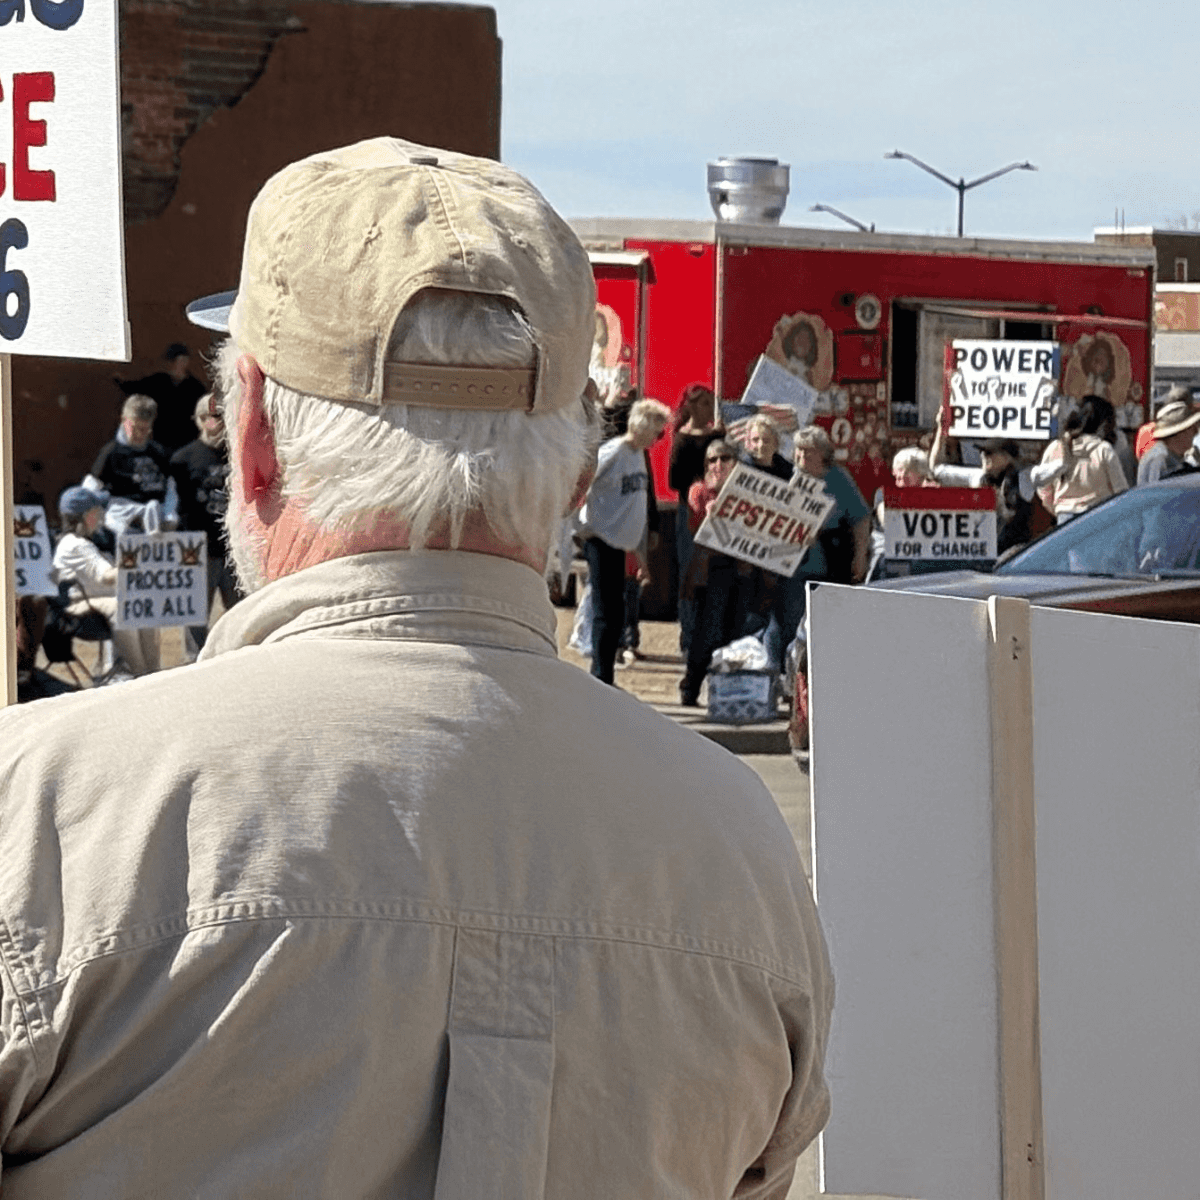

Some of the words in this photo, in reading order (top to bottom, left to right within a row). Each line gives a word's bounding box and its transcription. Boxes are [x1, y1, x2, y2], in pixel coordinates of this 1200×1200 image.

[952, 347, 1053, 373] POWER
[971, 380, 988, 397] TO
[1000, 382, 1027, 398] THE
[950, 405, 1053, 432] PEOPLE
[735, 471, 795, 505] RELEASE
[801, 496, 825, 517] THE
[794, 477, 817, 495] ALL
[716, 494, 812, 545] EPSTEIN
[140, 542, 176, 563] DUE
[894, 541, 921, 557] FOR
[931, 541, 987, 557] CHANGE
[126, 569, 195, 592] PROCESS
[122, 598, 154, 621] FOR
[161, 595, 196, 617] ALL
